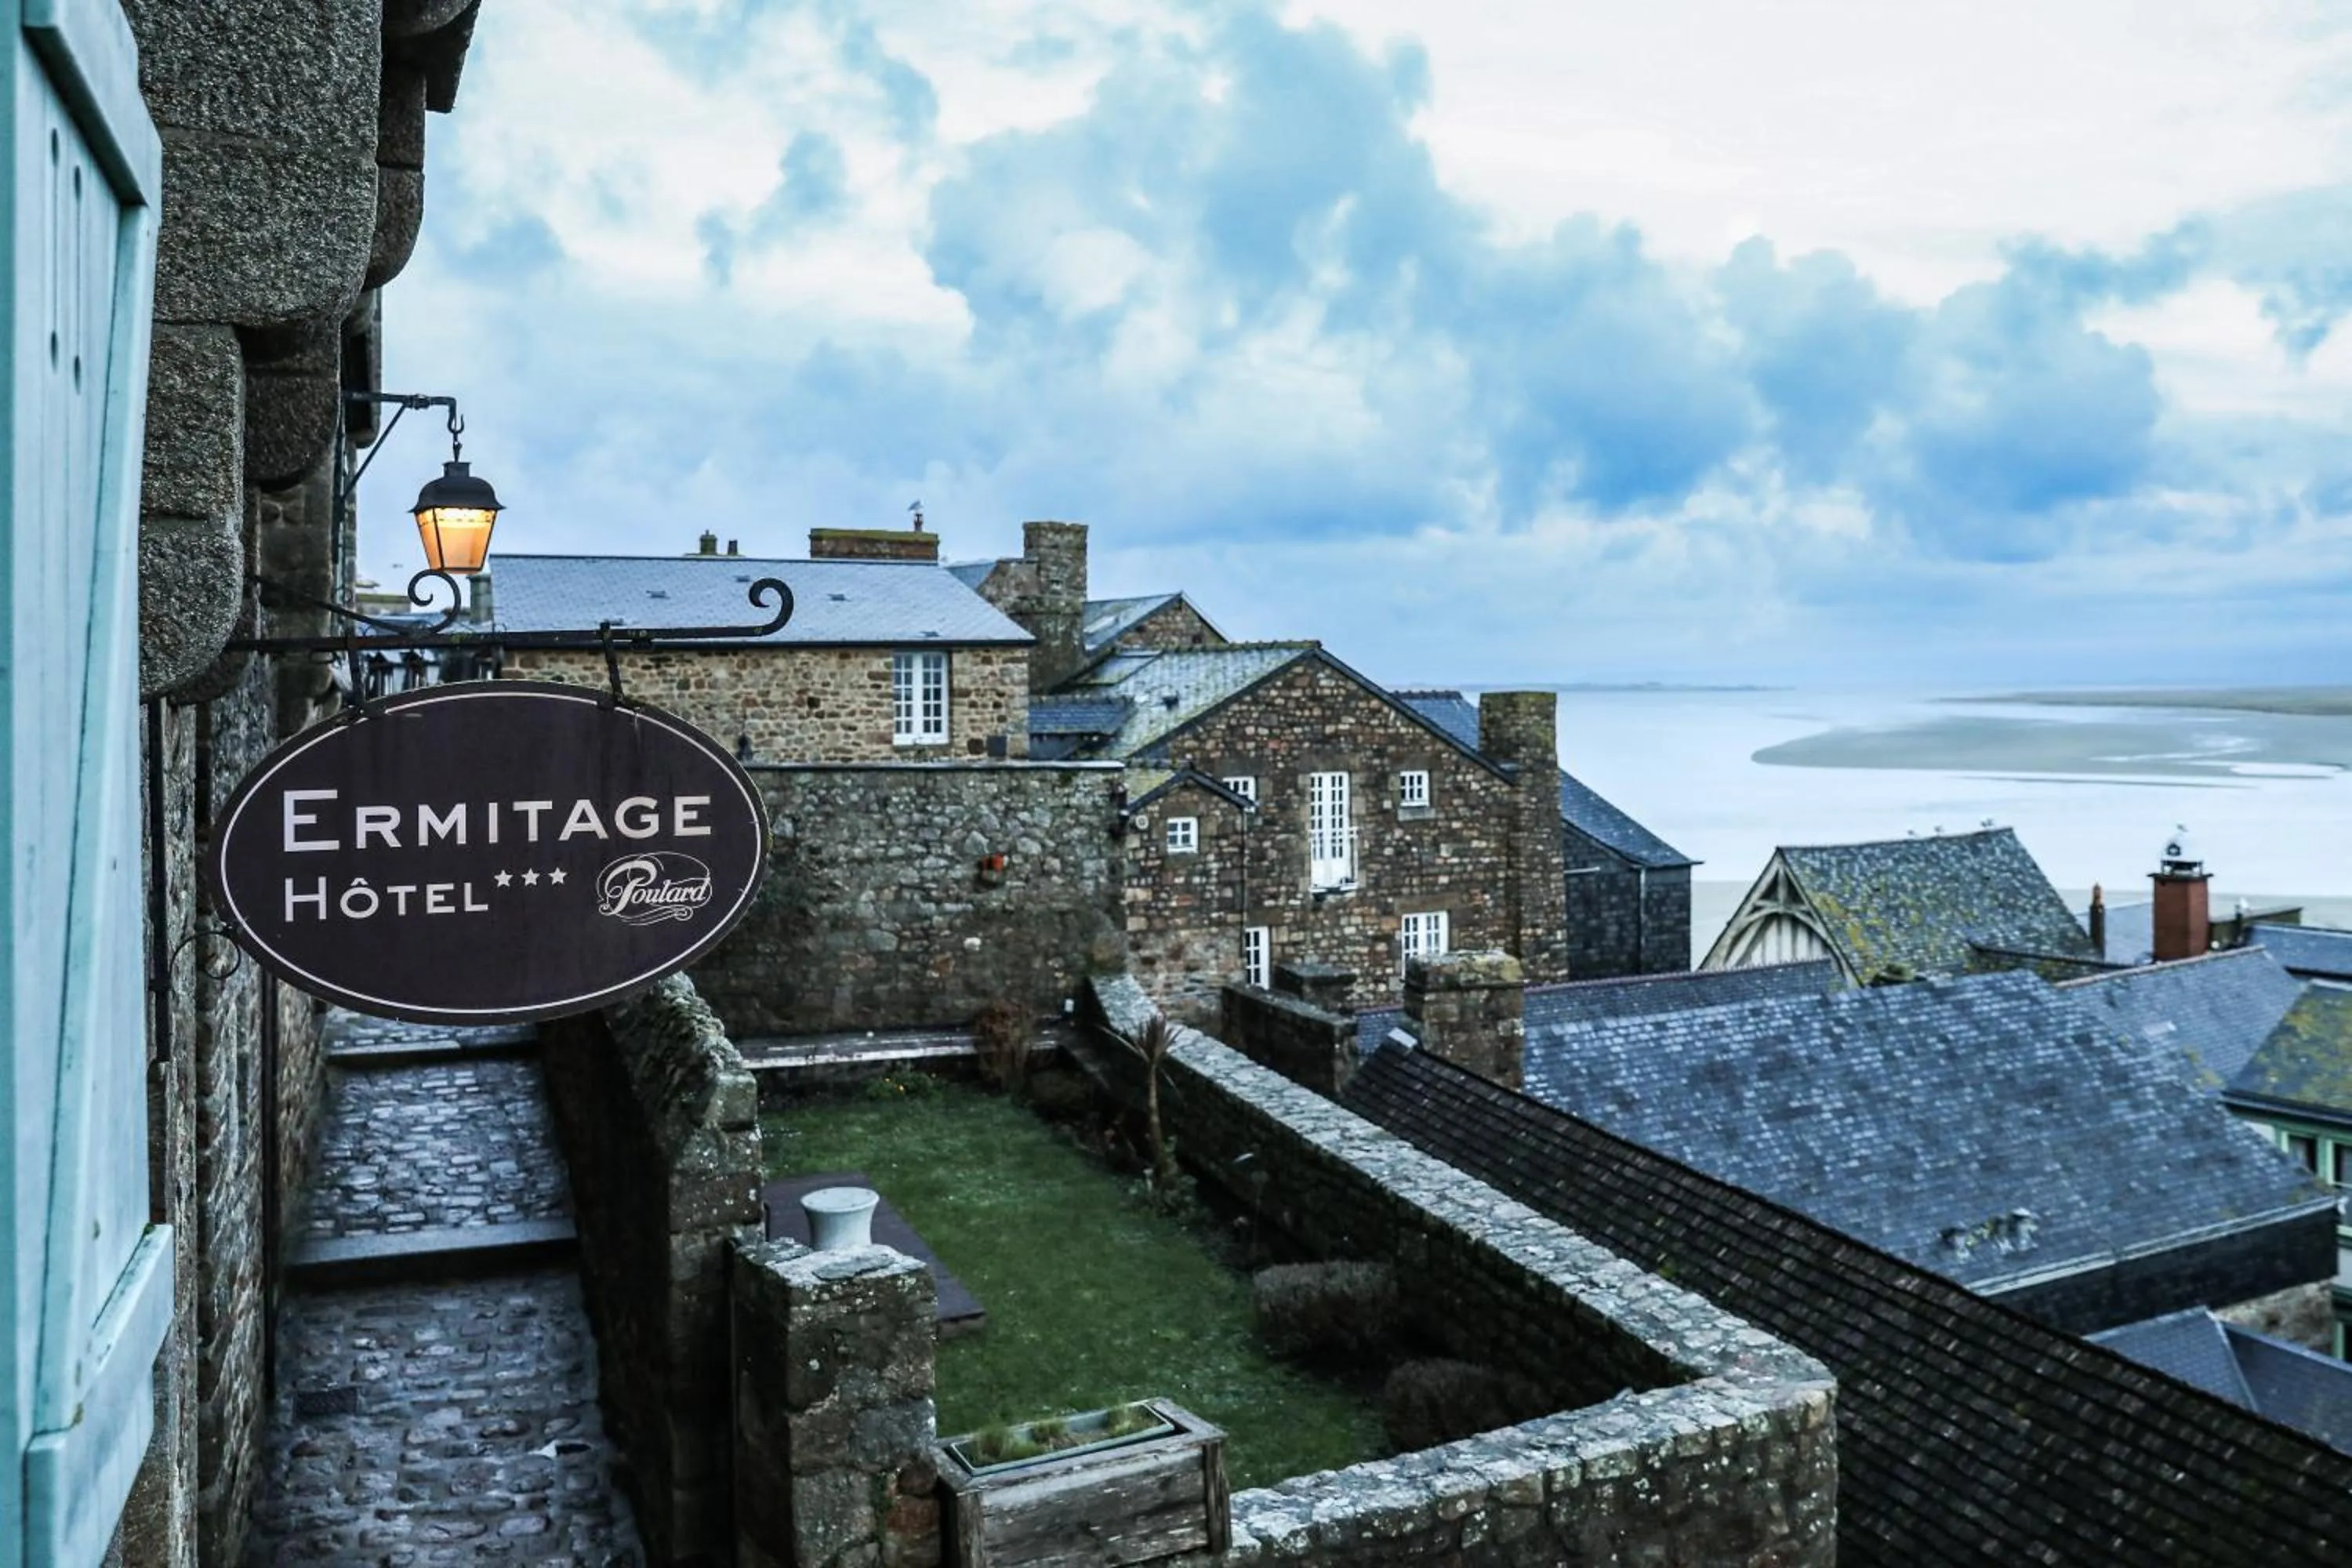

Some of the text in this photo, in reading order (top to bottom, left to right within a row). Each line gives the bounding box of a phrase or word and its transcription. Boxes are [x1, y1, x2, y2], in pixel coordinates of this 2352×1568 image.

[283, 789, 712, 852] ERMITAGE
[285, 877, 489, 922] HÔTEL
[599, 858, 711, 916] Poulard
